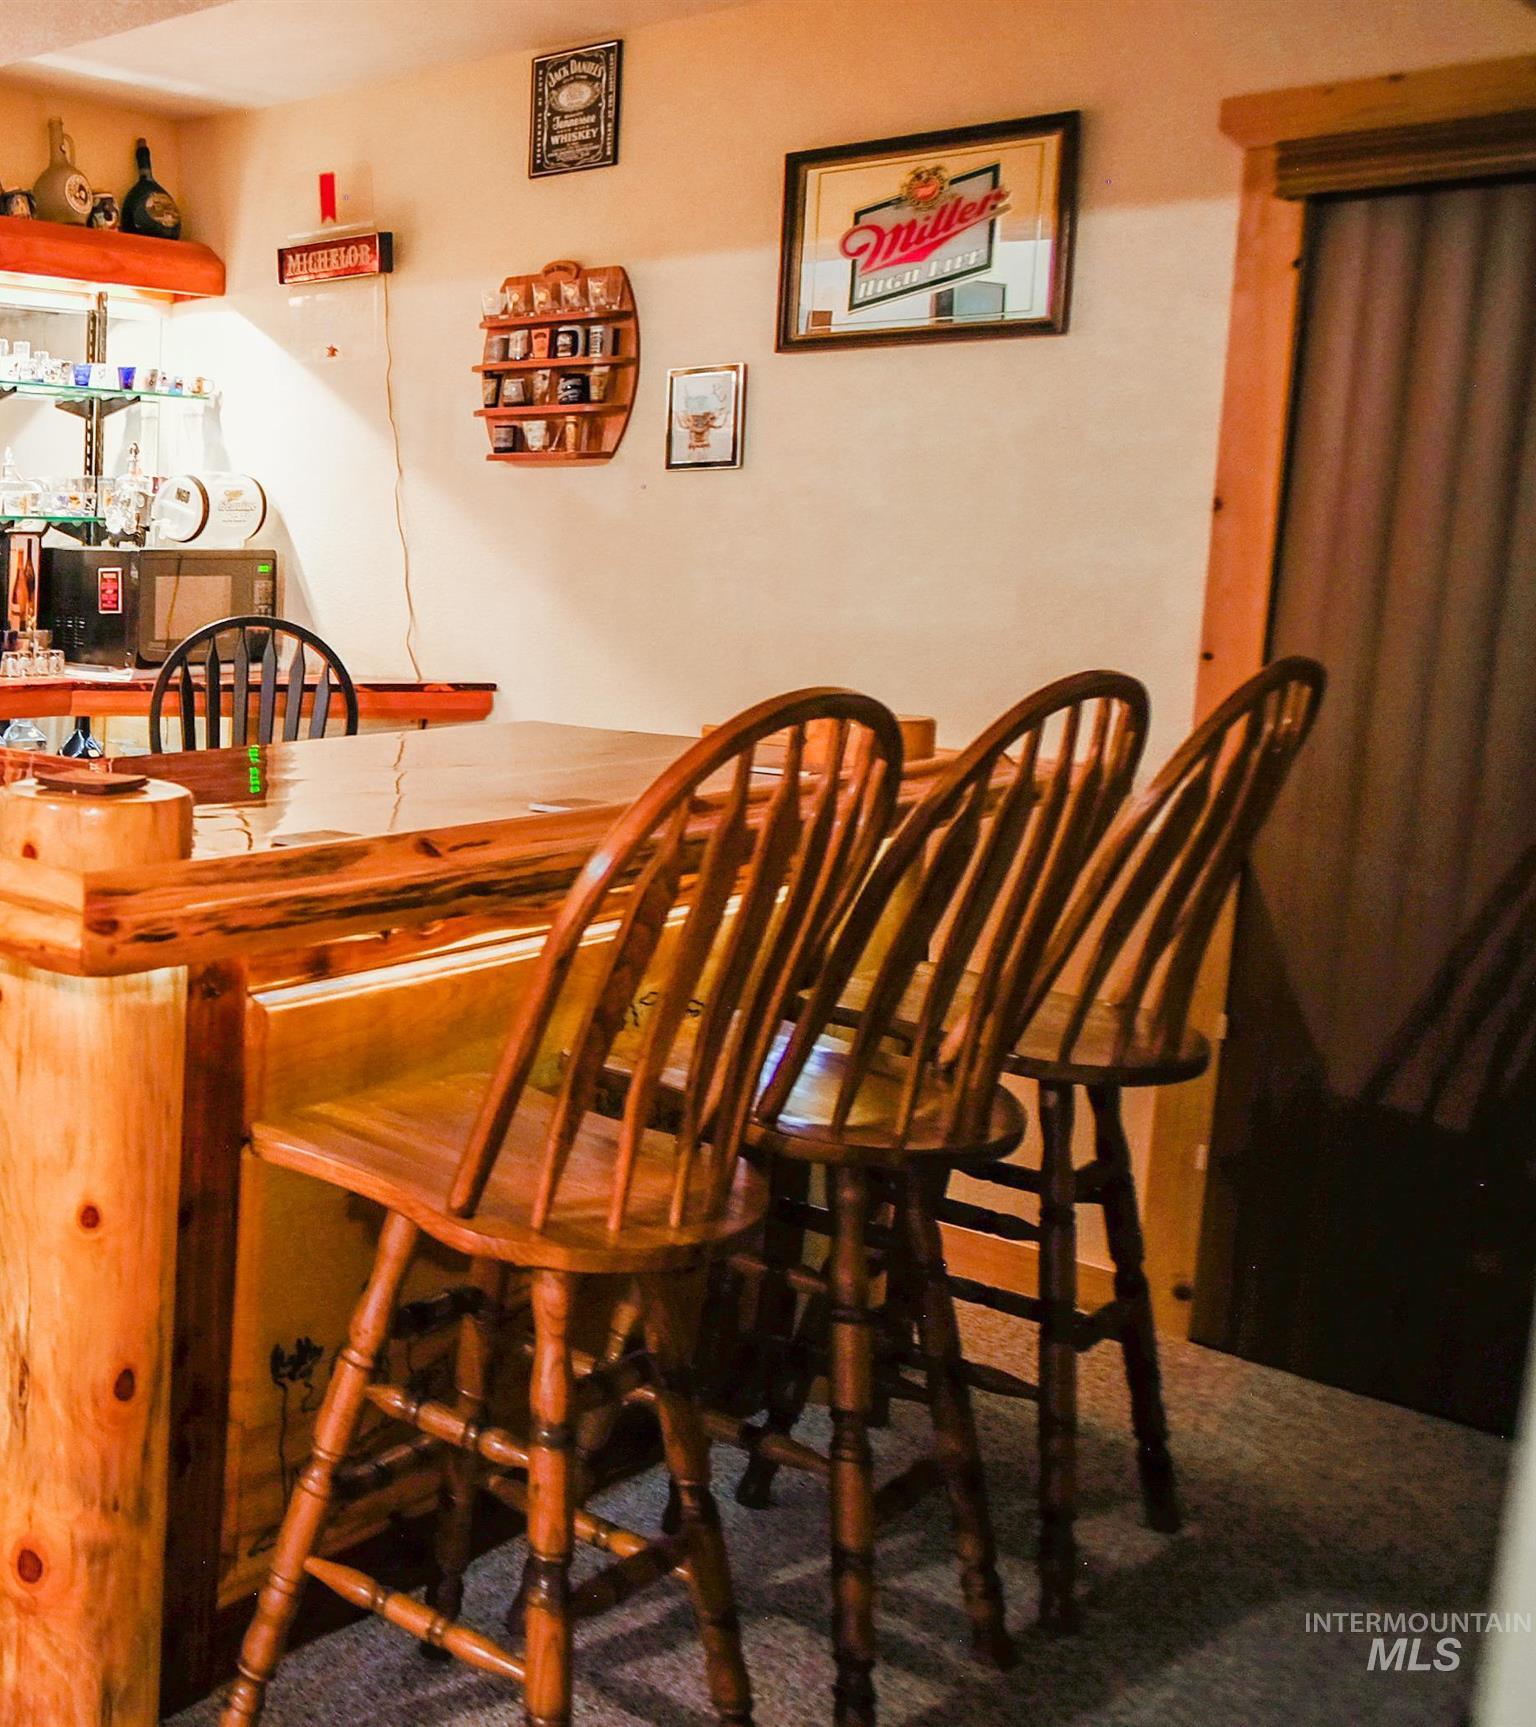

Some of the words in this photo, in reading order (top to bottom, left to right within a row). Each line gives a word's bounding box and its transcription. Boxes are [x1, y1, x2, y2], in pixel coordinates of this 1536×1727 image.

[550, 127, 599, 145] WHISKEY
[840, 187, 1010, 271] Miller
[286, 244, 371, 275] MICHELOB
